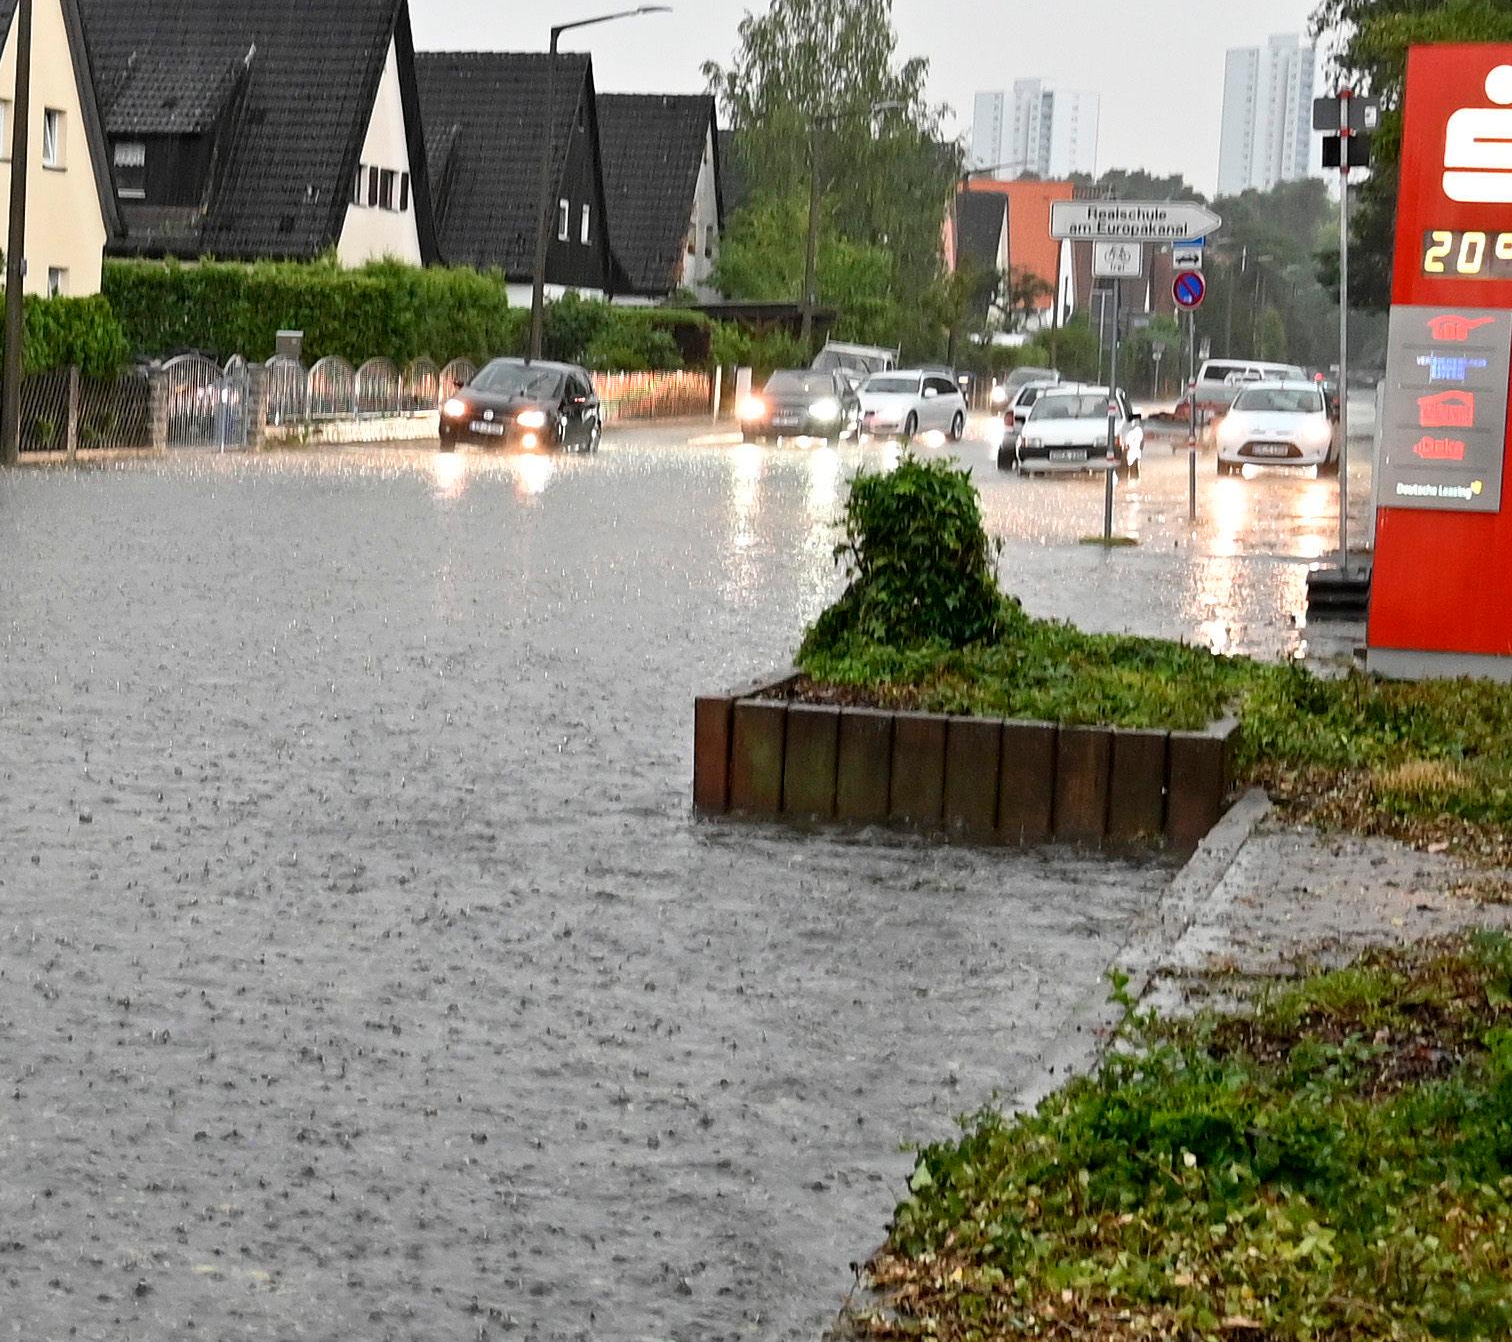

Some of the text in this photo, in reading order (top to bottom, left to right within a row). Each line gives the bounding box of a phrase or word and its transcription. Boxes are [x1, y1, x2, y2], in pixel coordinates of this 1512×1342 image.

[1087, 206, 1167, 221] Realschule
[1069, 221, 1189, 237] am Europakanal
